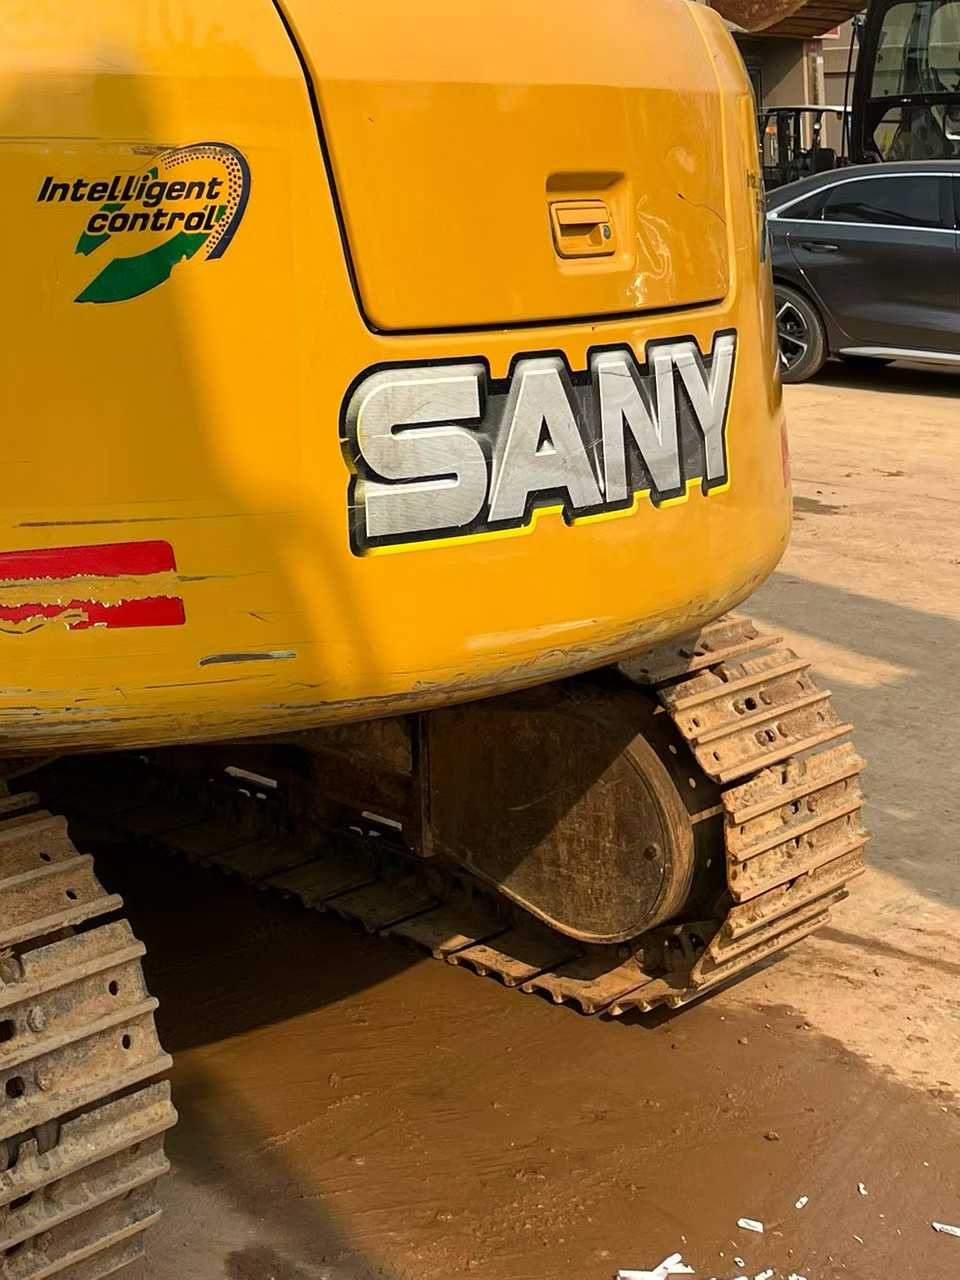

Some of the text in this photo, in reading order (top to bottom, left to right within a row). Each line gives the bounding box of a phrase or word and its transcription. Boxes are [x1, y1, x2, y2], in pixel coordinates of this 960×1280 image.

[37, 175, 223, 207] Intelligent
[86, 205, 218, 233] control
[346, 332, 736, 542] SANY
